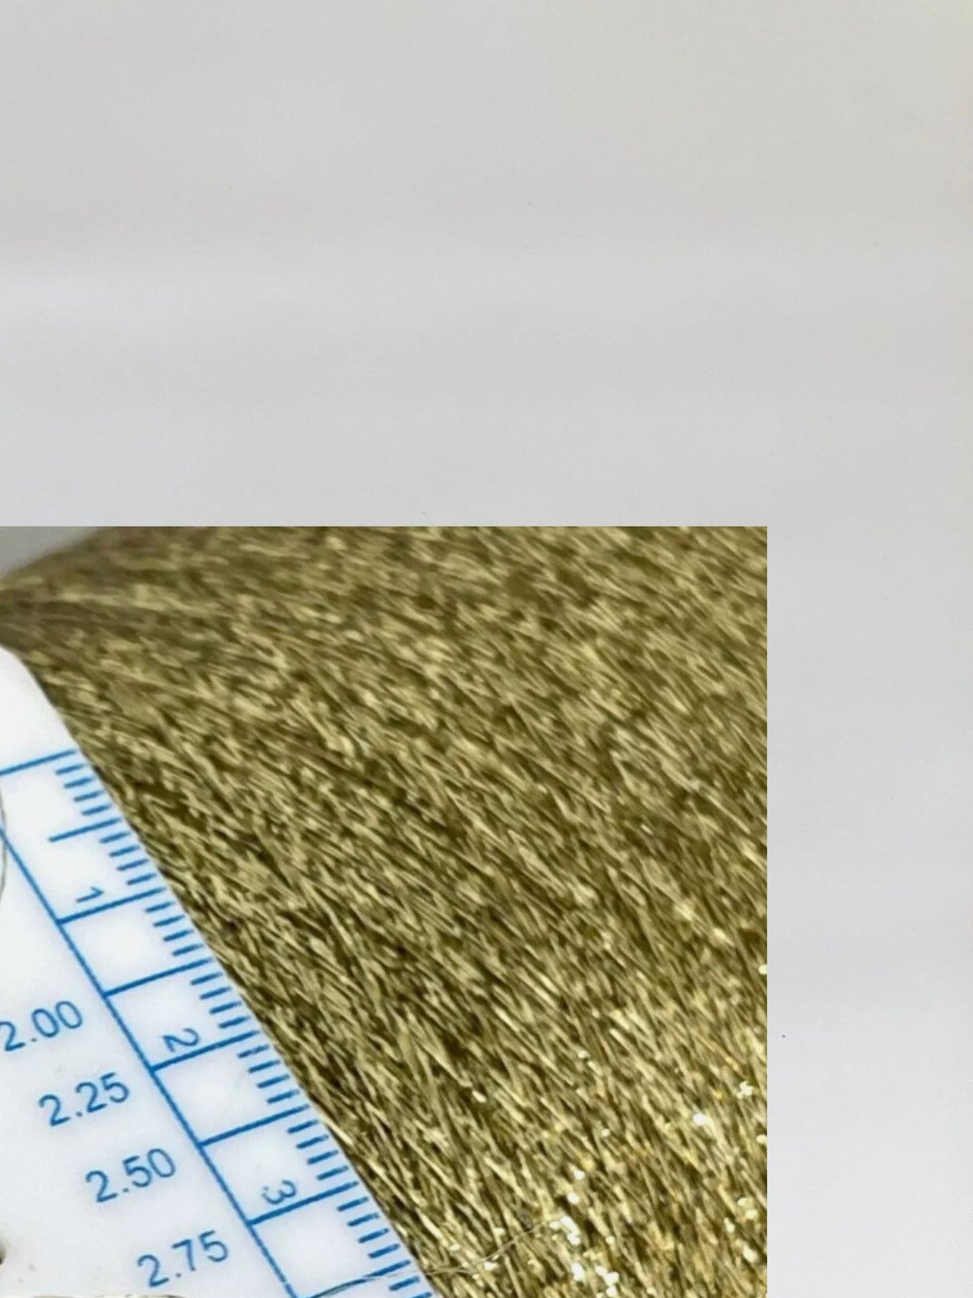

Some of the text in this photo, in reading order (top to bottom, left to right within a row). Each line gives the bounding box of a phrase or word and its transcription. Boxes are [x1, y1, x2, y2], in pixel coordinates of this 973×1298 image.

[77, 886, 104, 903] 1
[163, 1028, 200, 1053] 2
[39, 1072, 131, 1127] 2.25
[85, 1147, 177, 1203] 2.50
[262, 1178, 297, 1205] 3
[137, 1229, 229, 1288] 2.75
